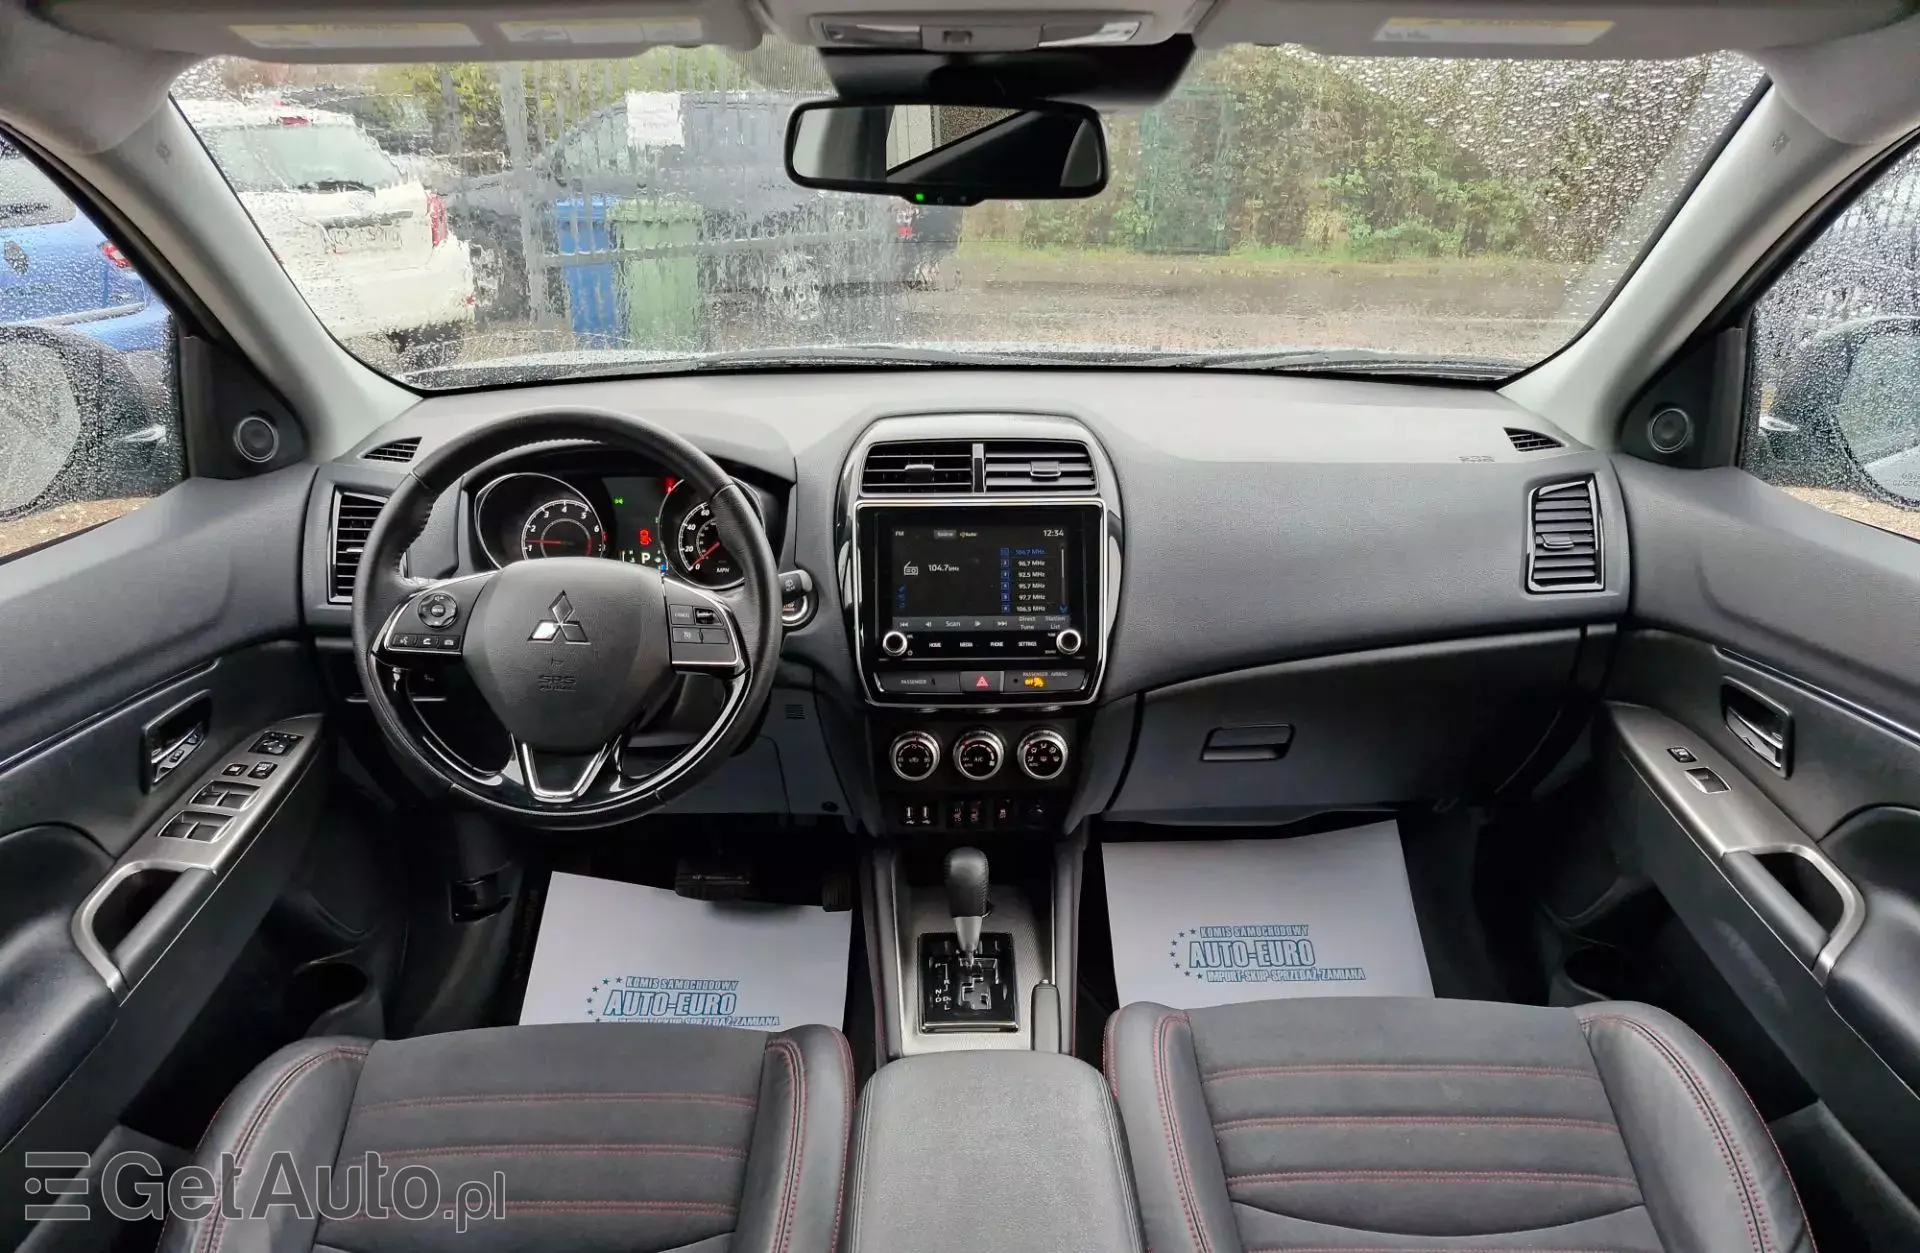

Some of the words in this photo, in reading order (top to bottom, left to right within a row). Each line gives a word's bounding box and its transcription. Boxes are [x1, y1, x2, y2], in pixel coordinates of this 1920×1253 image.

[1043, 529, 1065, 537] 12:34
[641, 552, 650, 564] P
[1200, 926, 1232, 939] KOMIS
[1233, 925, 1309, 938] SAMOCHODOWY
[1189, 939, 1316, 969] AUTO-EURO
[625, 976, 659, 989] KOMIS
[660, 979, 739, 991] SAMOCHODOWY
[603, 989, 737, 1016] AUTO-EURO
